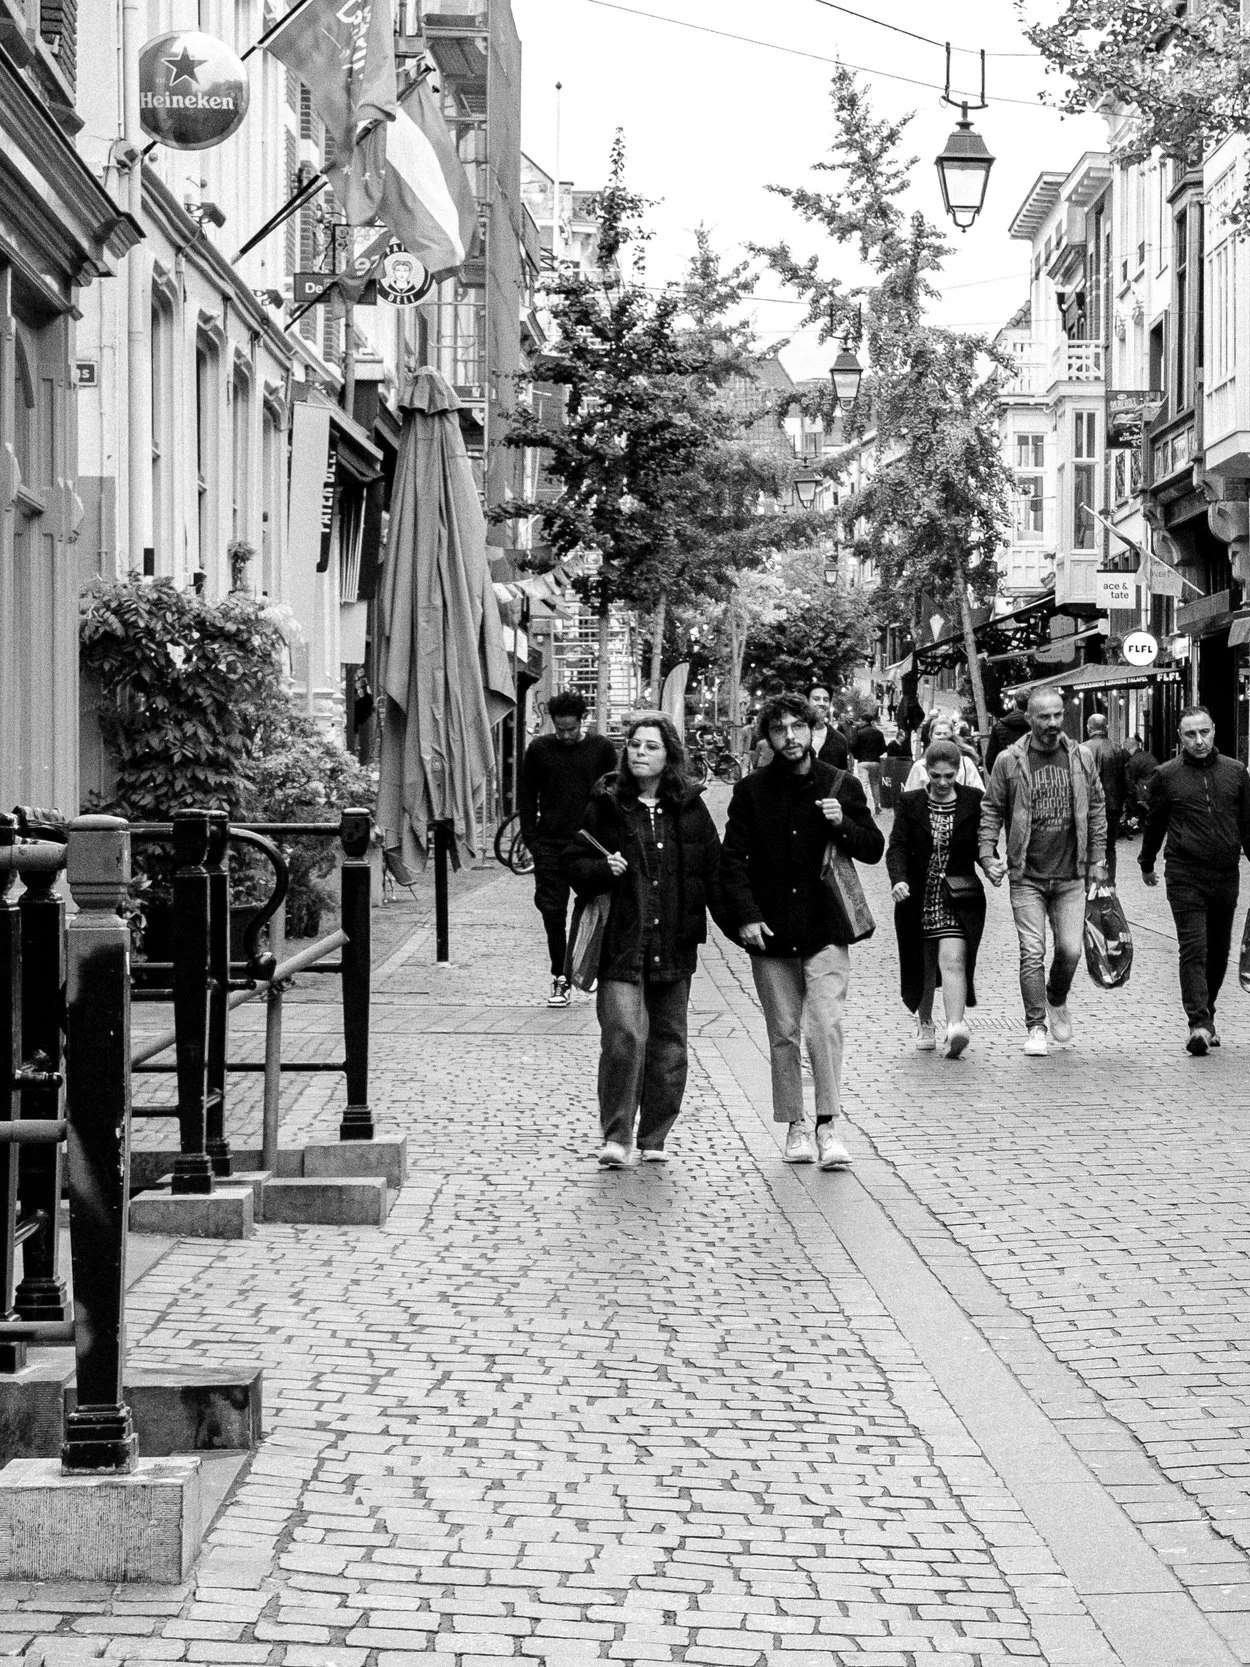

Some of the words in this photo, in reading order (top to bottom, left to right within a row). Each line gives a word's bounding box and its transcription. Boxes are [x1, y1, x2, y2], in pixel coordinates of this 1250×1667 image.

[140, 91, 235, 110] Heineken
[387, 294, 416, 304] DELI
[1122, 582, 1129, 590] &
[1110, 591, 1129, 599] tate
[1128, 645, 1153, 653] FLFL
[1156, 671, 1182, 682] FLFL
[1035, 796, 1070, 810] GOODS
